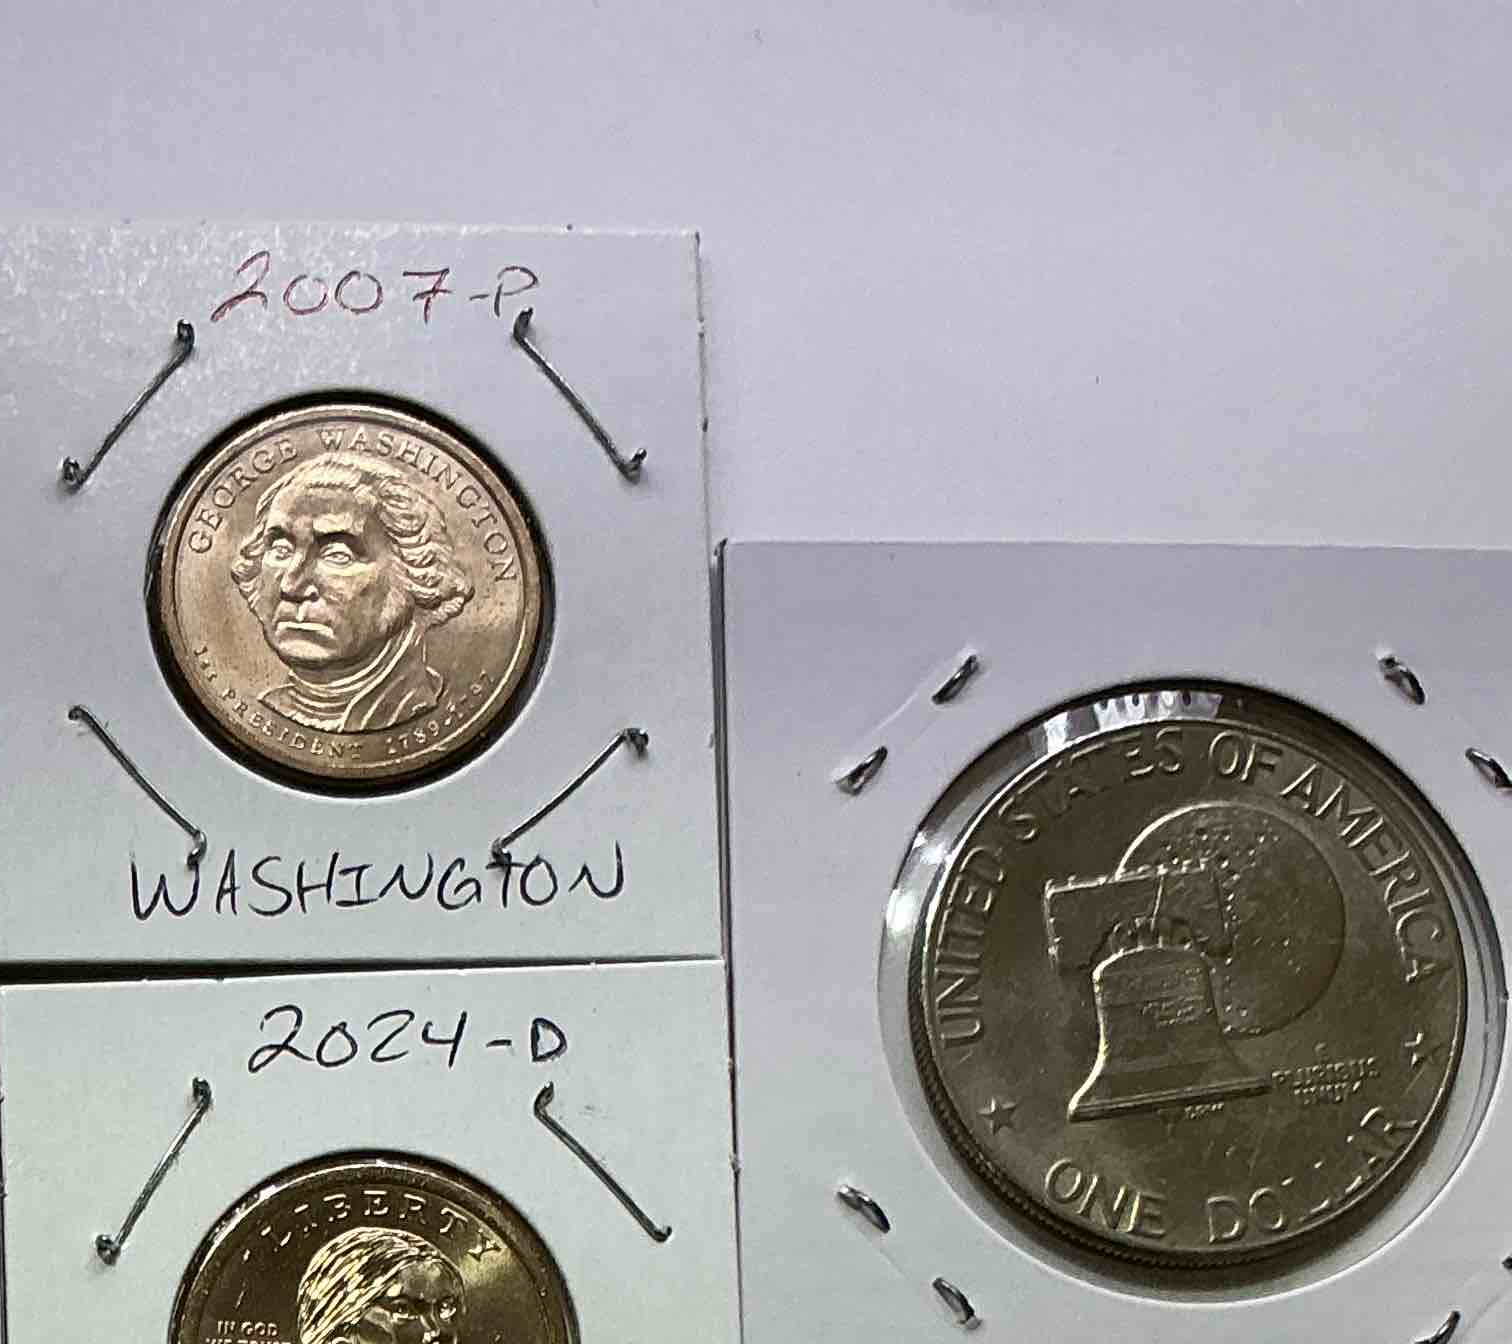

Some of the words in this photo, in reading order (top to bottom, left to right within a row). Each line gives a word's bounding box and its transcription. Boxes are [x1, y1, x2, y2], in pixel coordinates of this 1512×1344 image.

[210, 250, 539, 324] 2007-P
[188, 438, 300, 556] GEORGE
[317, 426, 519, 585] WASHINGTON
[129, 839, 626, 922] WASHINGTON
[935, 844, 1007, 1050] UNITED
[1208, 728, 1284, 784] OF
[1278, 762, 1453, 985] AMERICA
[247, 1004, 569, 1074] 2024-D
[1043, 1157, 1166, 1240] ONE
[217, 1320, 236, 1337] IN
[241, 1321, 280, 1337] GOD
